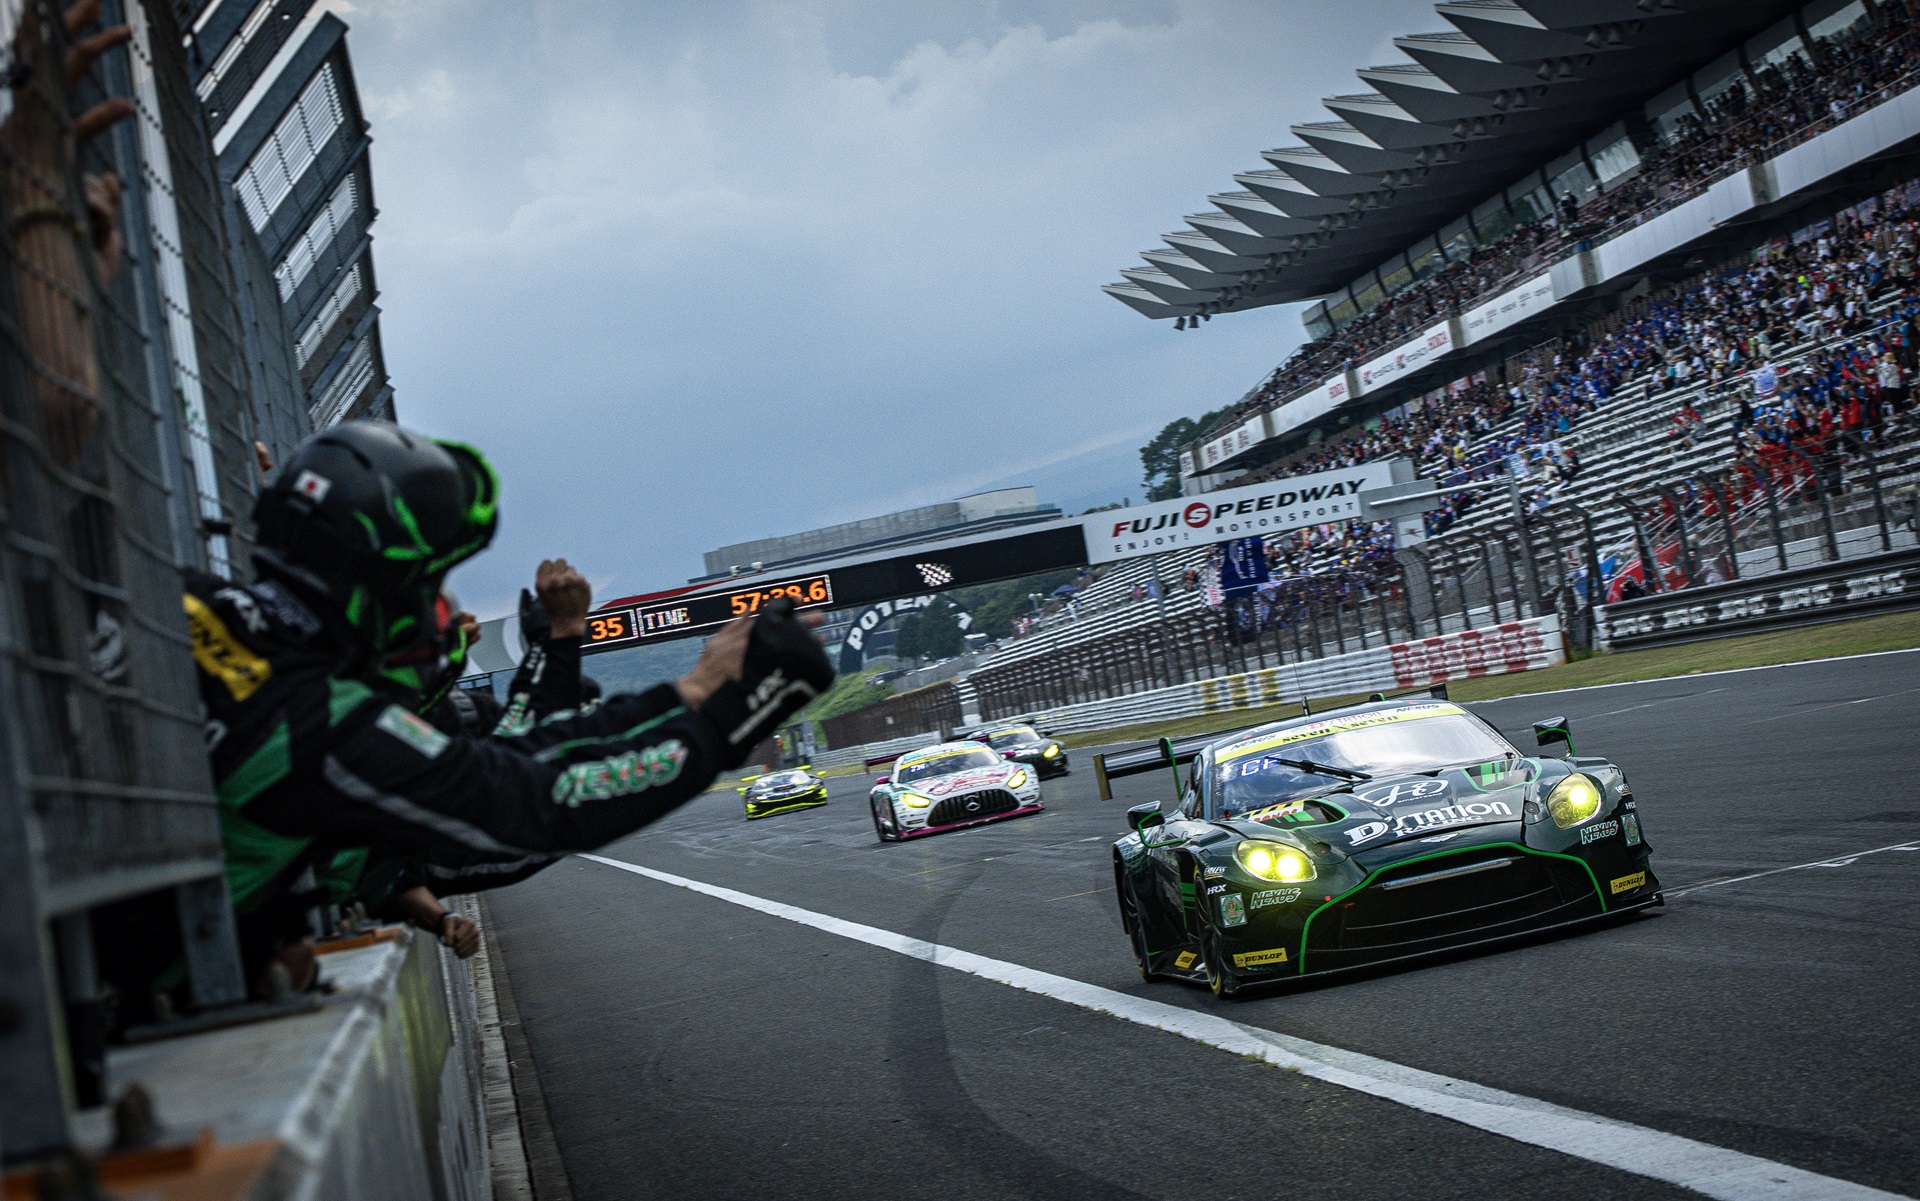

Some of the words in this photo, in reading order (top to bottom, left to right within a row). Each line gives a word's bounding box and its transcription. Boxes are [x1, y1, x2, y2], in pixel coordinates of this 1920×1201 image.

[1111, 512, 1180, 537] FUJI
[1183, 478, 1367, 529] SPEEDWAY
[1114, 532, 1190, 553] ENJOY!
[1214, 501, 1355, 535] MOTORSPORT
[590, 616, 625, 641] 35
[1343, 801, 1514, 848] D'STATION
[1394, 815, 1486, 838] RACING
[1580, 820, 1619, 846] NEXUS
[1207, 883, 1228, 896] HRX
[1618, 875, 1644, 888] DUNLOP
[1249, 887, 1302, 910] NEXUS
[1245, 952, 1283, 963] DUNLOP
